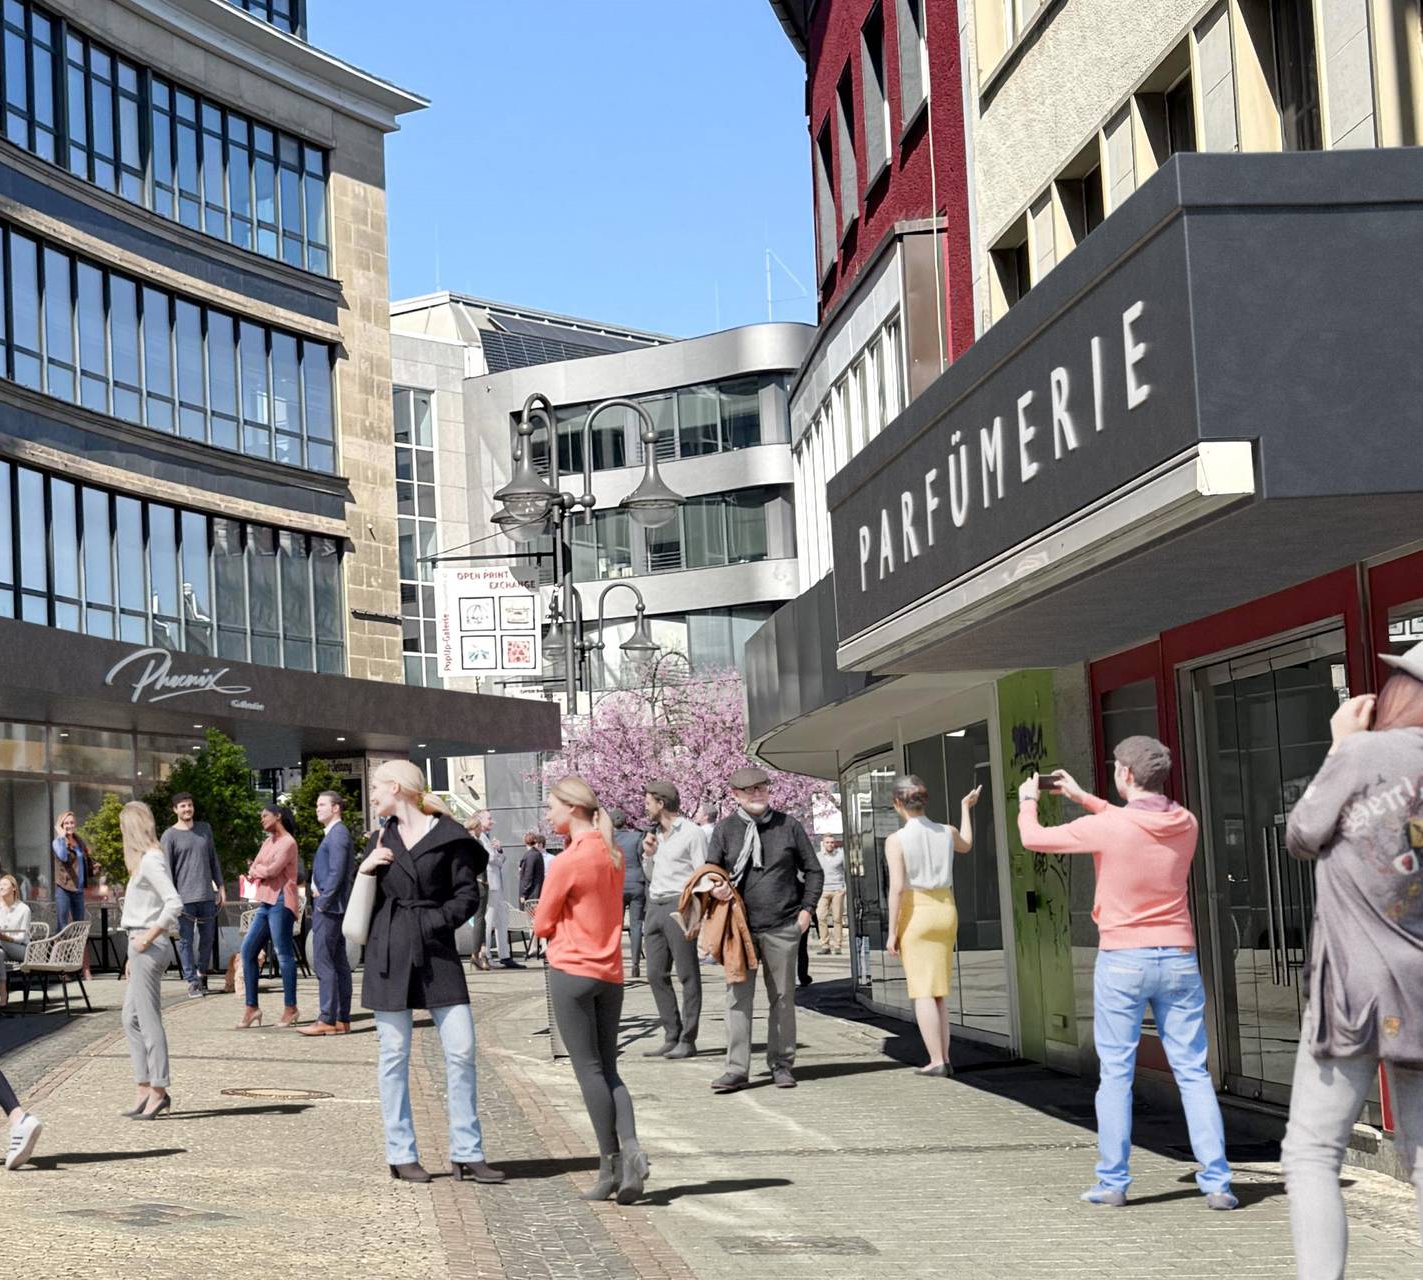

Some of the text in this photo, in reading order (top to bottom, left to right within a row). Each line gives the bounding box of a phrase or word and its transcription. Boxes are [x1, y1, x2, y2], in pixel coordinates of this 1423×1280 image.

[859, 300, 1153, 592] PARFÜMERIE
[457, 571, 508, 580] OPEN PRINT
[489, 580, 536, 589] EXCHANGE
[105, 647, 251, 703] Phoenix
